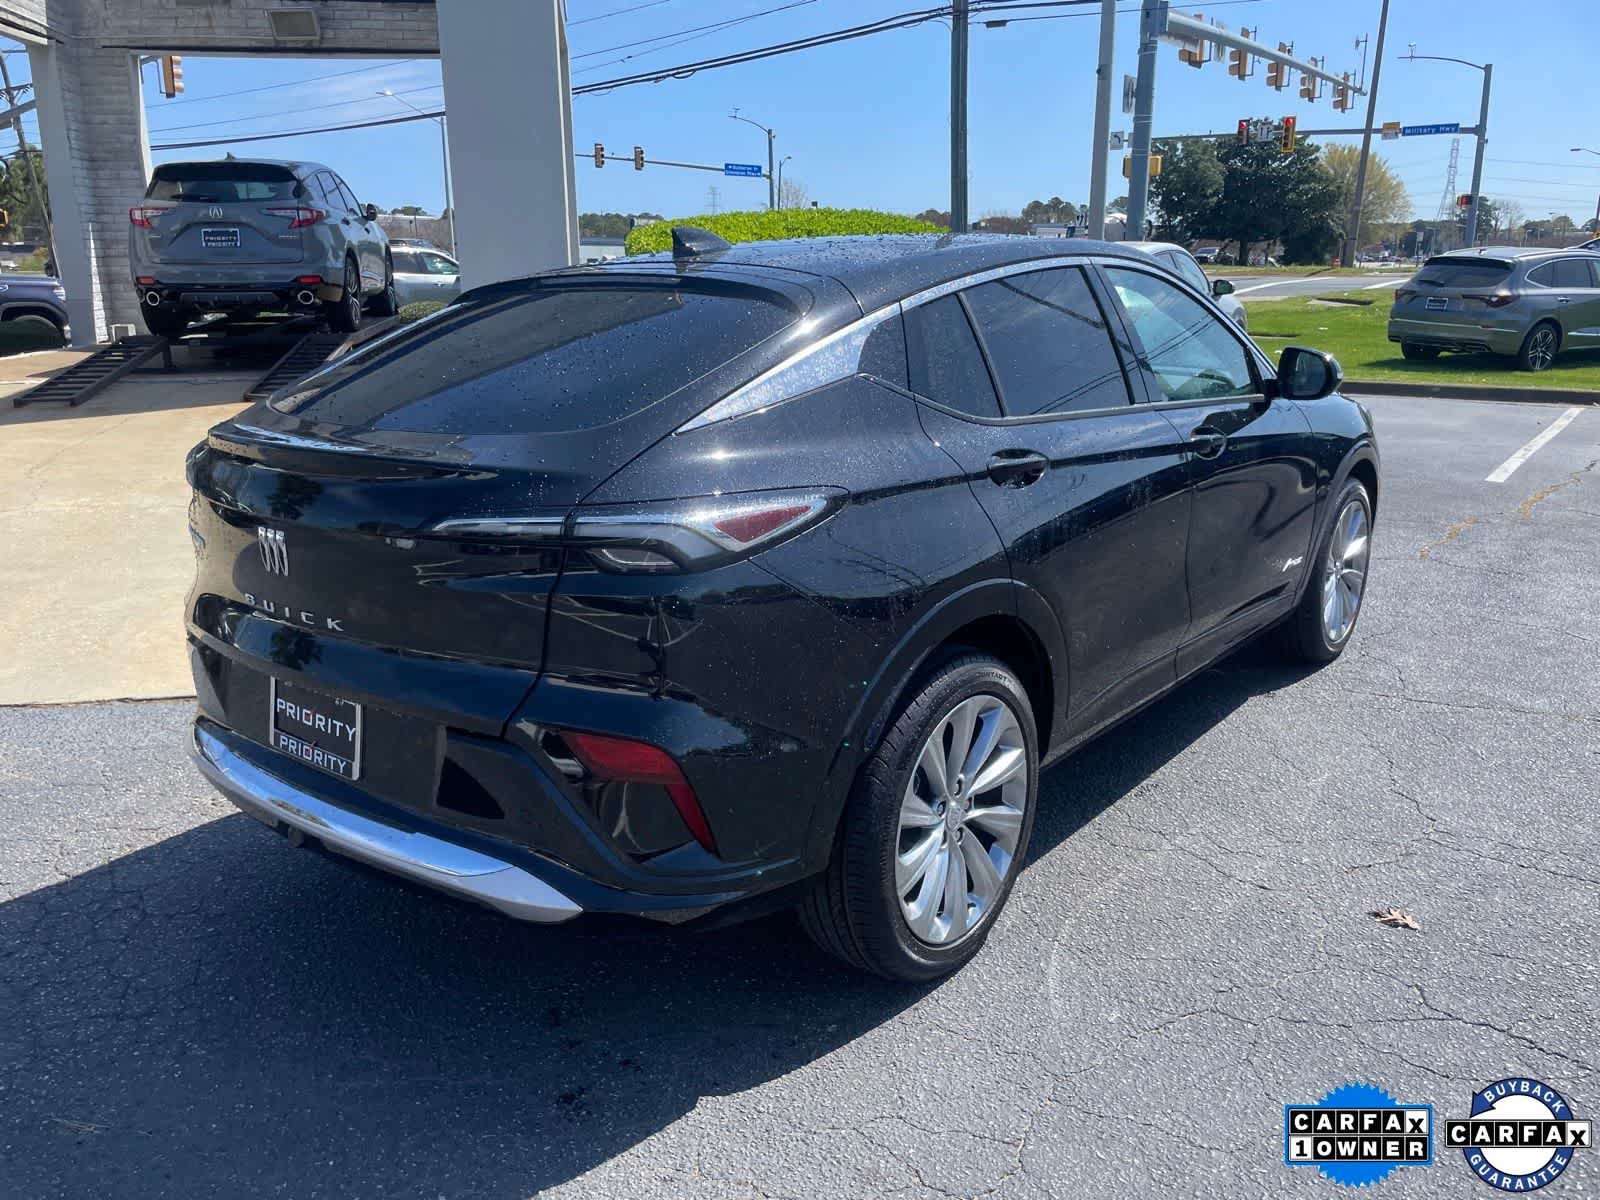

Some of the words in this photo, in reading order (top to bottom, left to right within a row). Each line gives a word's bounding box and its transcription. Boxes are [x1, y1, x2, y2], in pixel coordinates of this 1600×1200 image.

[245, 593, 344, 632] BUICK
[276, 698, 356, 742] PRIORITY
[280, 735, 347, 774] PRIORITY
